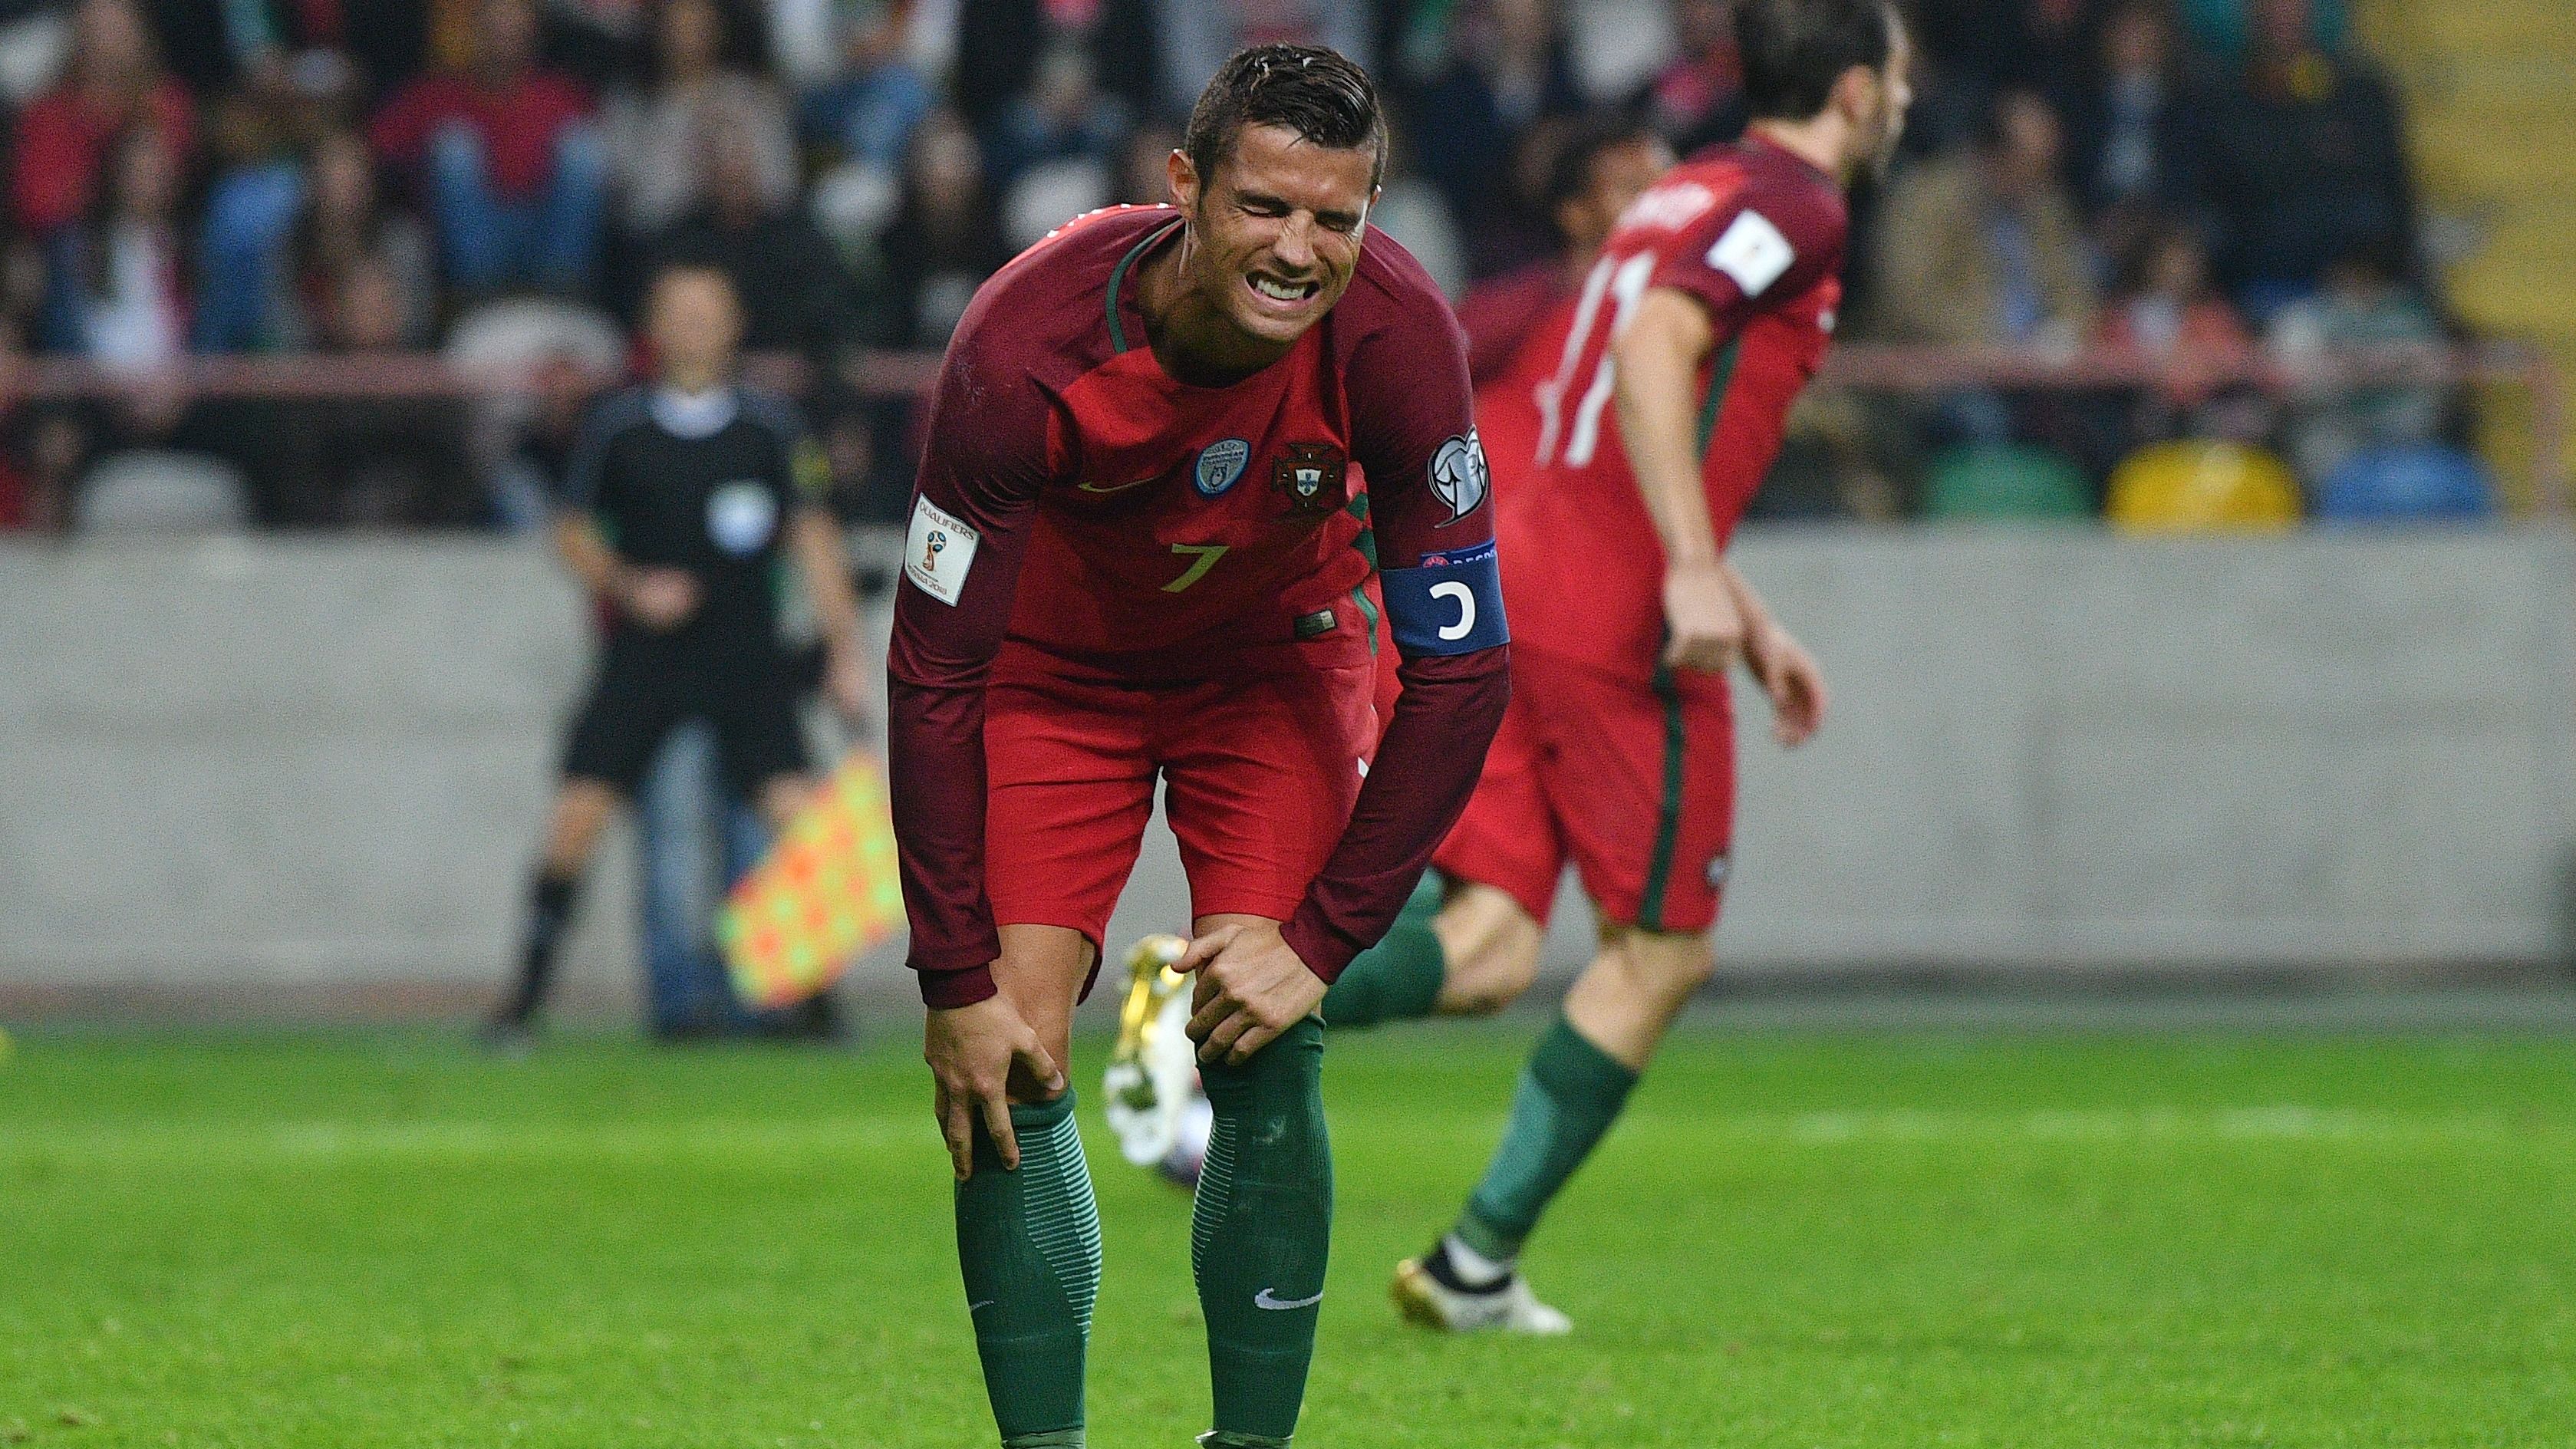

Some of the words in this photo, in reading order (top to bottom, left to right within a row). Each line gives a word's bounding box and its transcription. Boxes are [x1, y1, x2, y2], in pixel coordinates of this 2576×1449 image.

[920, 502, 975, 541] QUALIFIERS
[1161, 543, 1230, 593] 7
[1429, 581, 1475, 641] C
